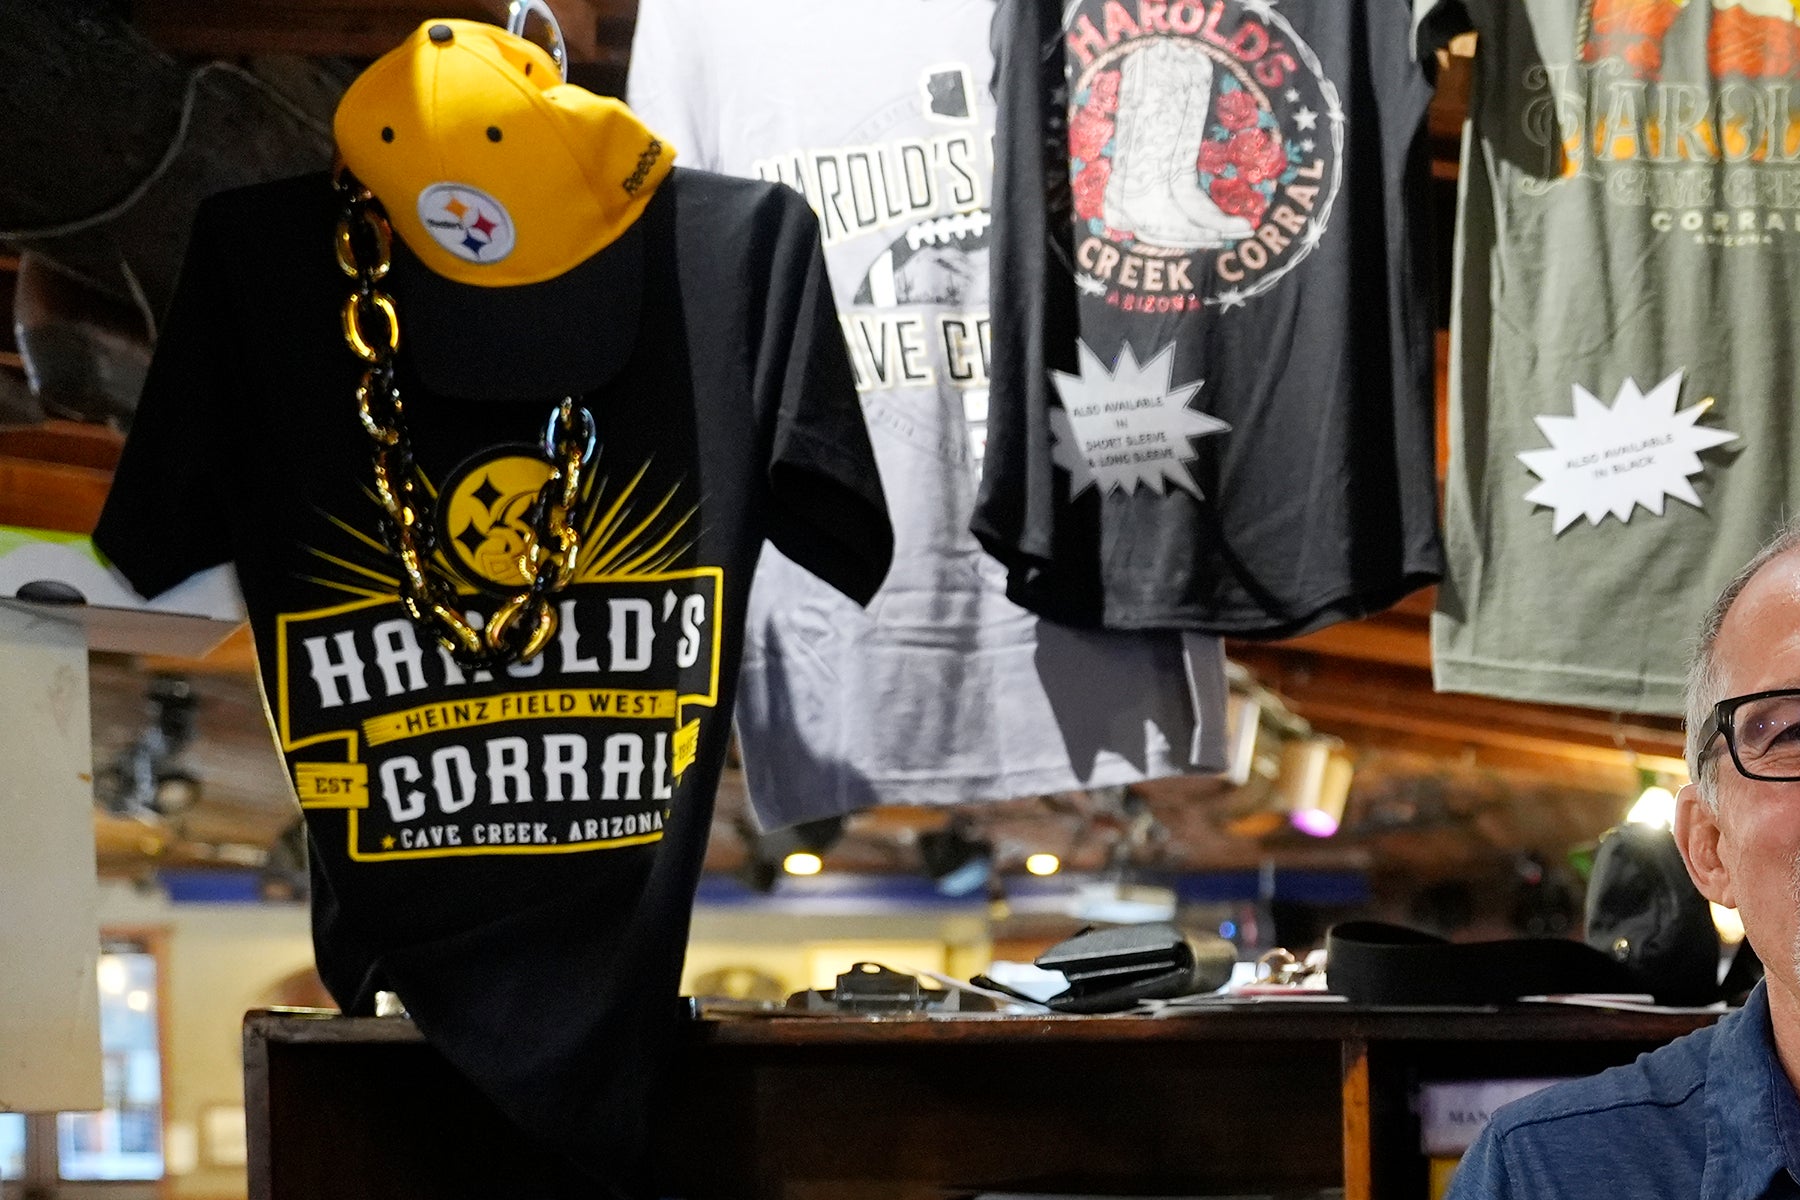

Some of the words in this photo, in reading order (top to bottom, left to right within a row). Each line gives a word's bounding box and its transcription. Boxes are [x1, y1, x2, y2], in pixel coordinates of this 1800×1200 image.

[1067, 0, 1297, 88] HAROLD'S
[622, 135, 662, 197] Reebok
[756, 134, 980, 243] ROLD'S
[1216, 158, 1325, 283] CORRAL
[1076, 237, 1195, 292] CREEK
[1073, 402, 1102, 418] ALSO
[1104, 396, 1166, 413] AVAILABLE
[1085, 436, 1123, 452] SHORT
[1126, 431, 1168, 447] SLEEVE
[1566, 453, 1600, 469] ALSO
[1604, 432, 1675, 458] AVAILABLE
[1611, 455, 1657, 474] BLACK
[303, 588, 707, 709] HALD'S
[405, 701, 491, 736] HEINZ
[500, 692, 577, 716] FIELD
[588, 692, 660, 715] WEST
[313, 776, 353, 794] EST
[378, 731, 674, 824] CORRAL
[400, 823, 463, 850] CAVE
[472, 821, 558, 847] CREEK,
[567, 809, 665, 842] ARIZONA
